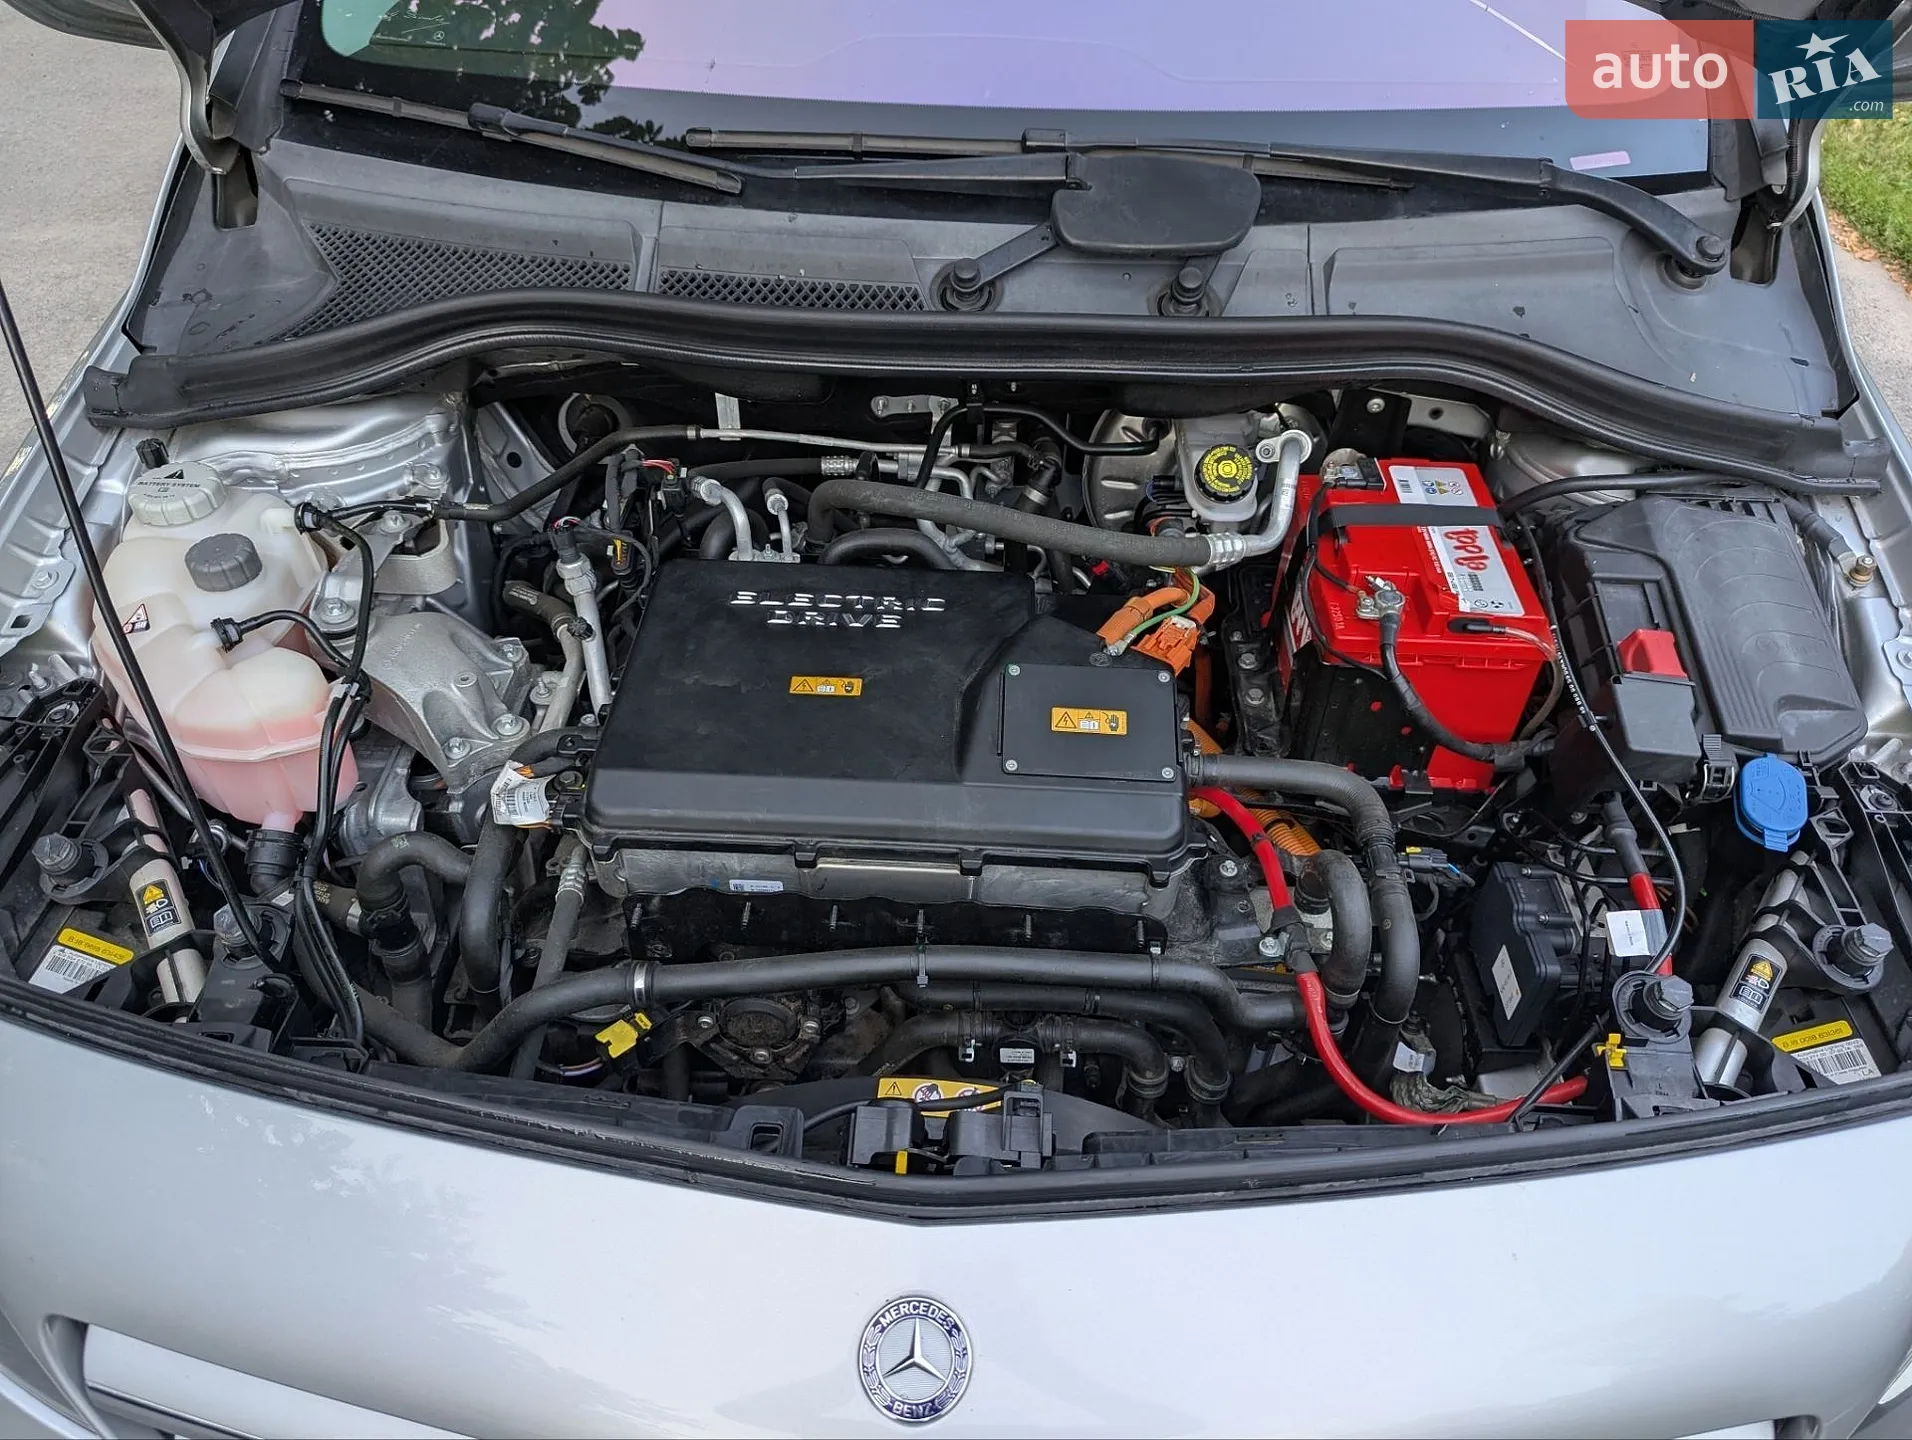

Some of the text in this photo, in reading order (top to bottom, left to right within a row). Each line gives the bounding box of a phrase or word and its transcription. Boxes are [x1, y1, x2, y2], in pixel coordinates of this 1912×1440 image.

[729, 591, 946, 611] ELECTRIC
[767, 609, 902, 628] DRIVE
[879, 1301, 955, 1330] MERCEDES
[892, 1401, 935, 1418] BENZ
